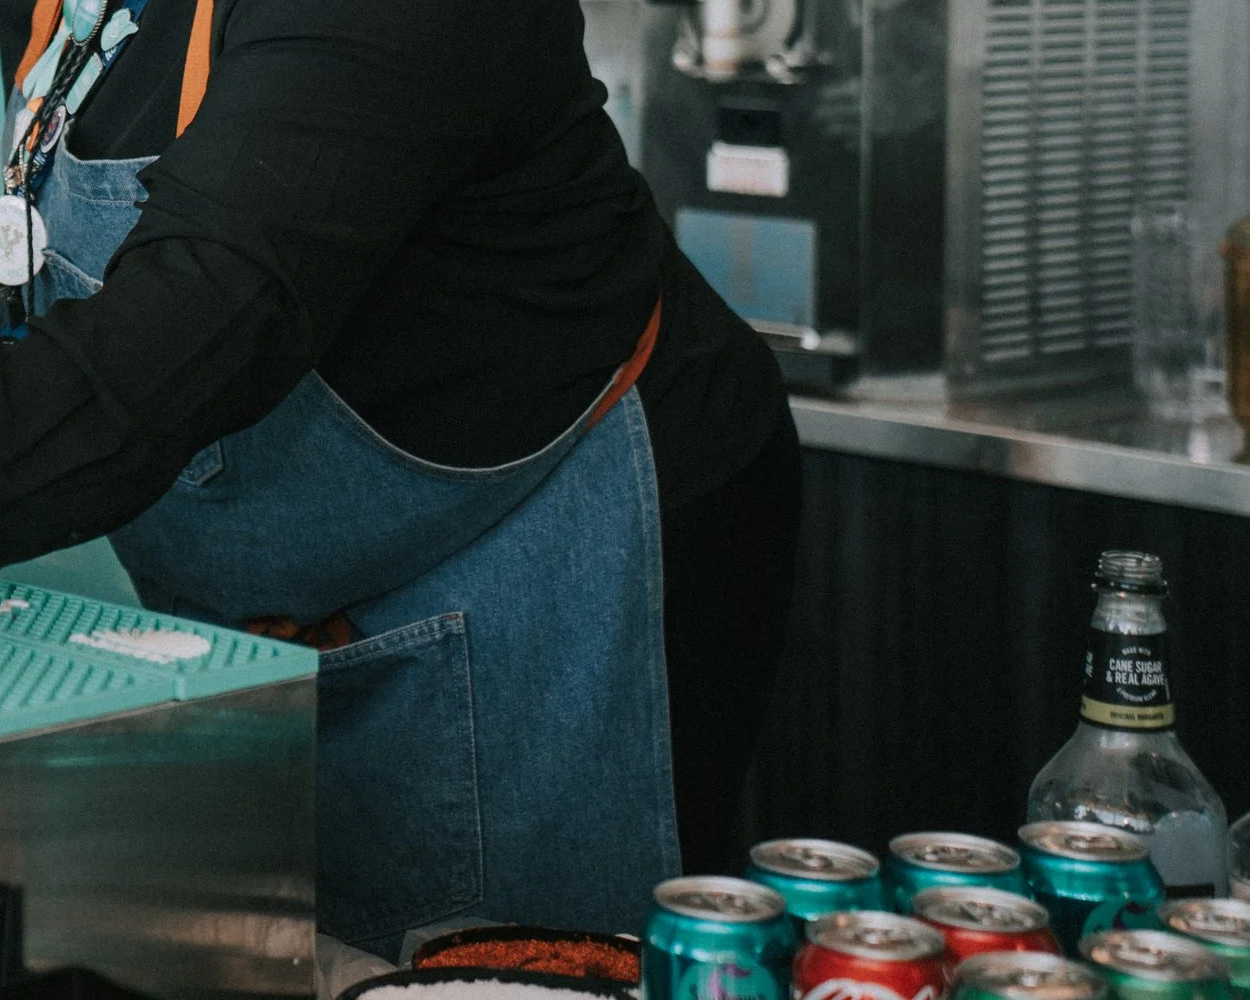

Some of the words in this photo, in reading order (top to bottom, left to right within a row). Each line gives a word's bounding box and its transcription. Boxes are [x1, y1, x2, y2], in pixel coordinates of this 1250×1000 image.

[1109, 658, 1133, 673] CANE
[1135, 660, 1162, 674] SUGAR
[1106, 670, 1113, 683] &
[1115, 671, 1139, 686] REAL
